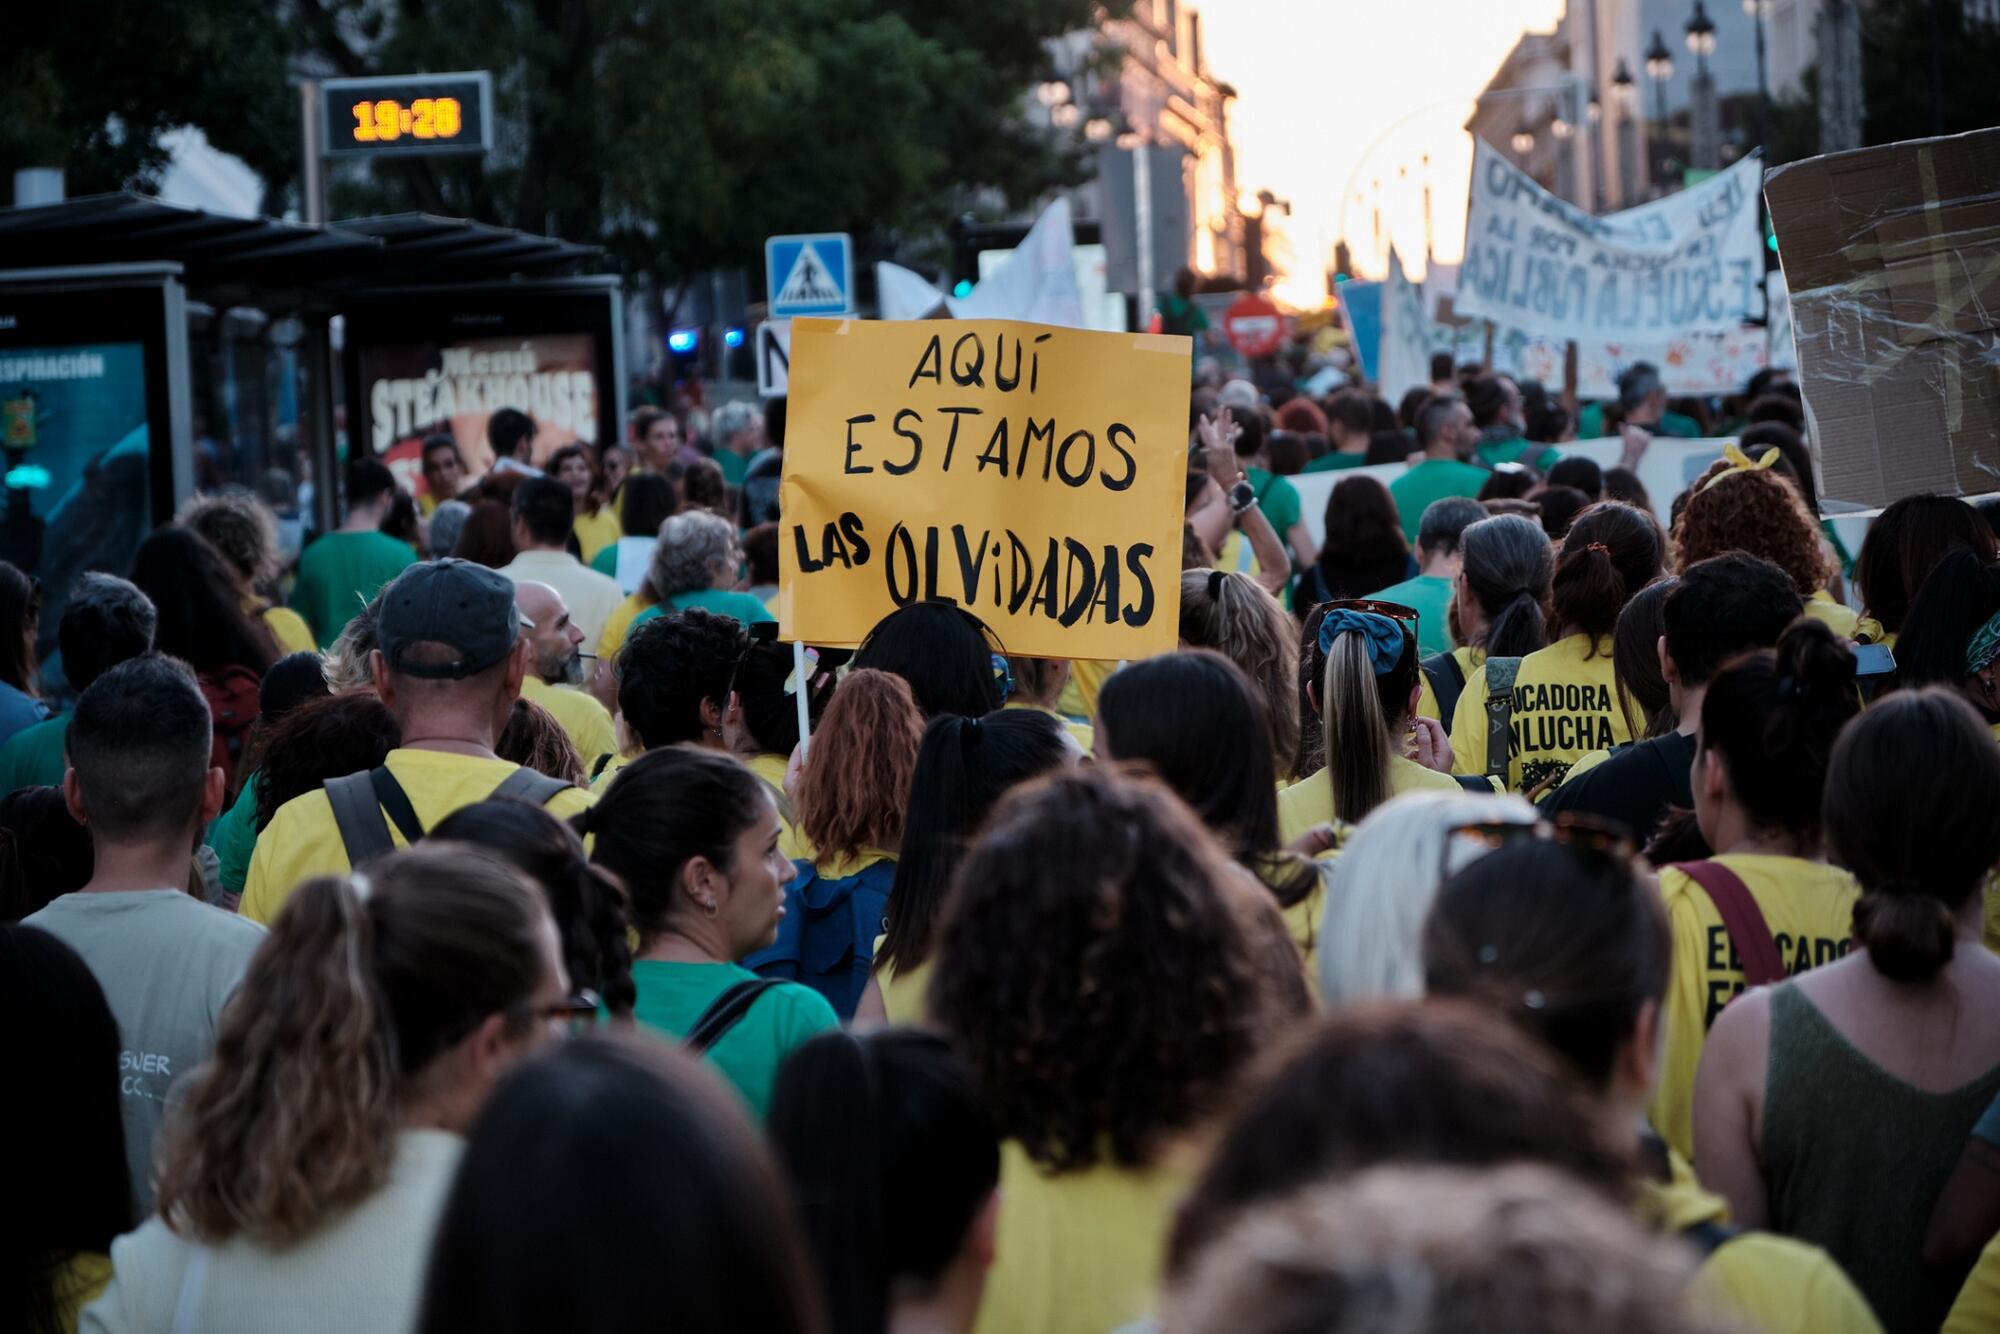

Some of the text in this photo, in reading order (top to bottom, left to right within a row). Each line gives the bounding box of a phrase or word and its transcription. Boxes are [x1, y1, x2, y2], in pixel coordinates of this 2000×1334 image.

[0, 351, 105, 382] SPIRACIÓN
[425, 341, 536, 384] Menú
[371, 371, 597, 453] STEAKHOUSE
[844, 407, 1137, 491] ESTAMOS
[793, 511, 871, 574] LAS
